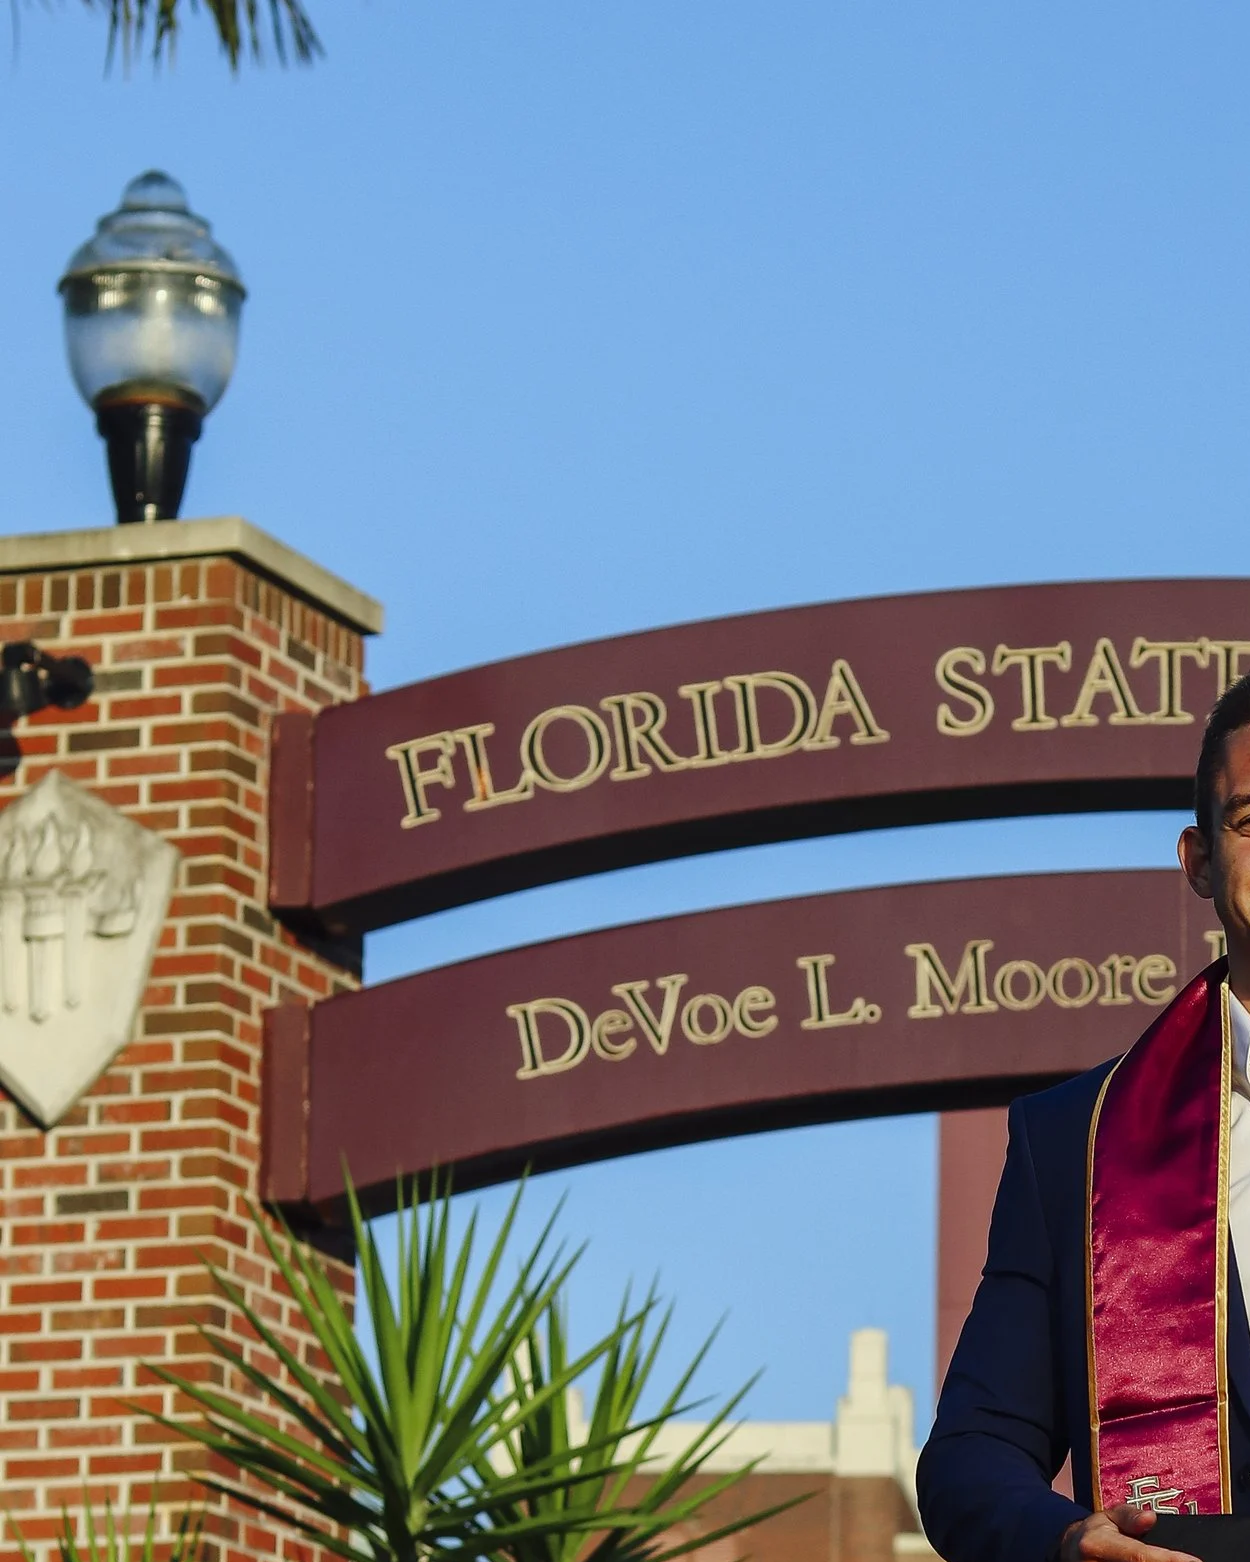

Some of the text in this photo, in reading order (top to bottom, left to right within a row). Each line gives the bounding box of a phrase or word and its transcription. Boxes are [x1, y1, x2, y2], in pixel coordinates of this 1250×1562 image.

[385, 659, 890, 829] FLORIDA
[506, 973, 778, 1081] DeVoe
[799, 954, 882, 1030] L.
[905, 939, 1177, 1020] Moore
